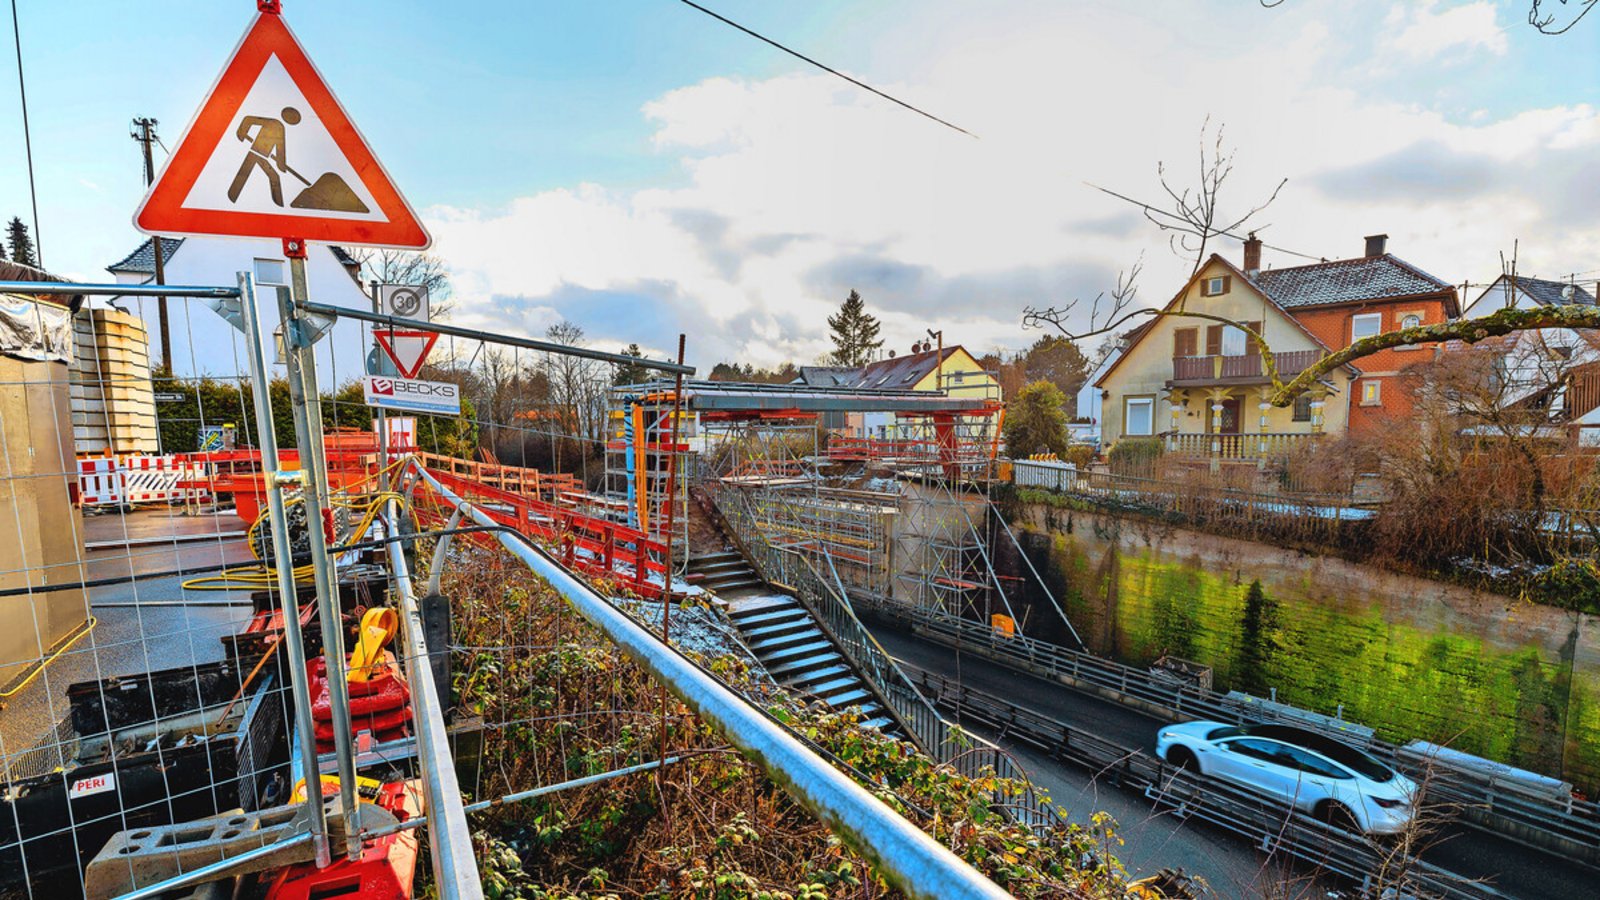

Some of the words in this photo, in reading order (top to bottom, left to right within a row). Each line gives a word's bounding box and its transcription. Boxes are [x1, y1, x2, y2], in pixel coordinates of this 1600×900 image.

[396, 295, 415, 309] 30
[394, 381, 455, 397] BECKS
[77, 776, 105, 791] PERI
